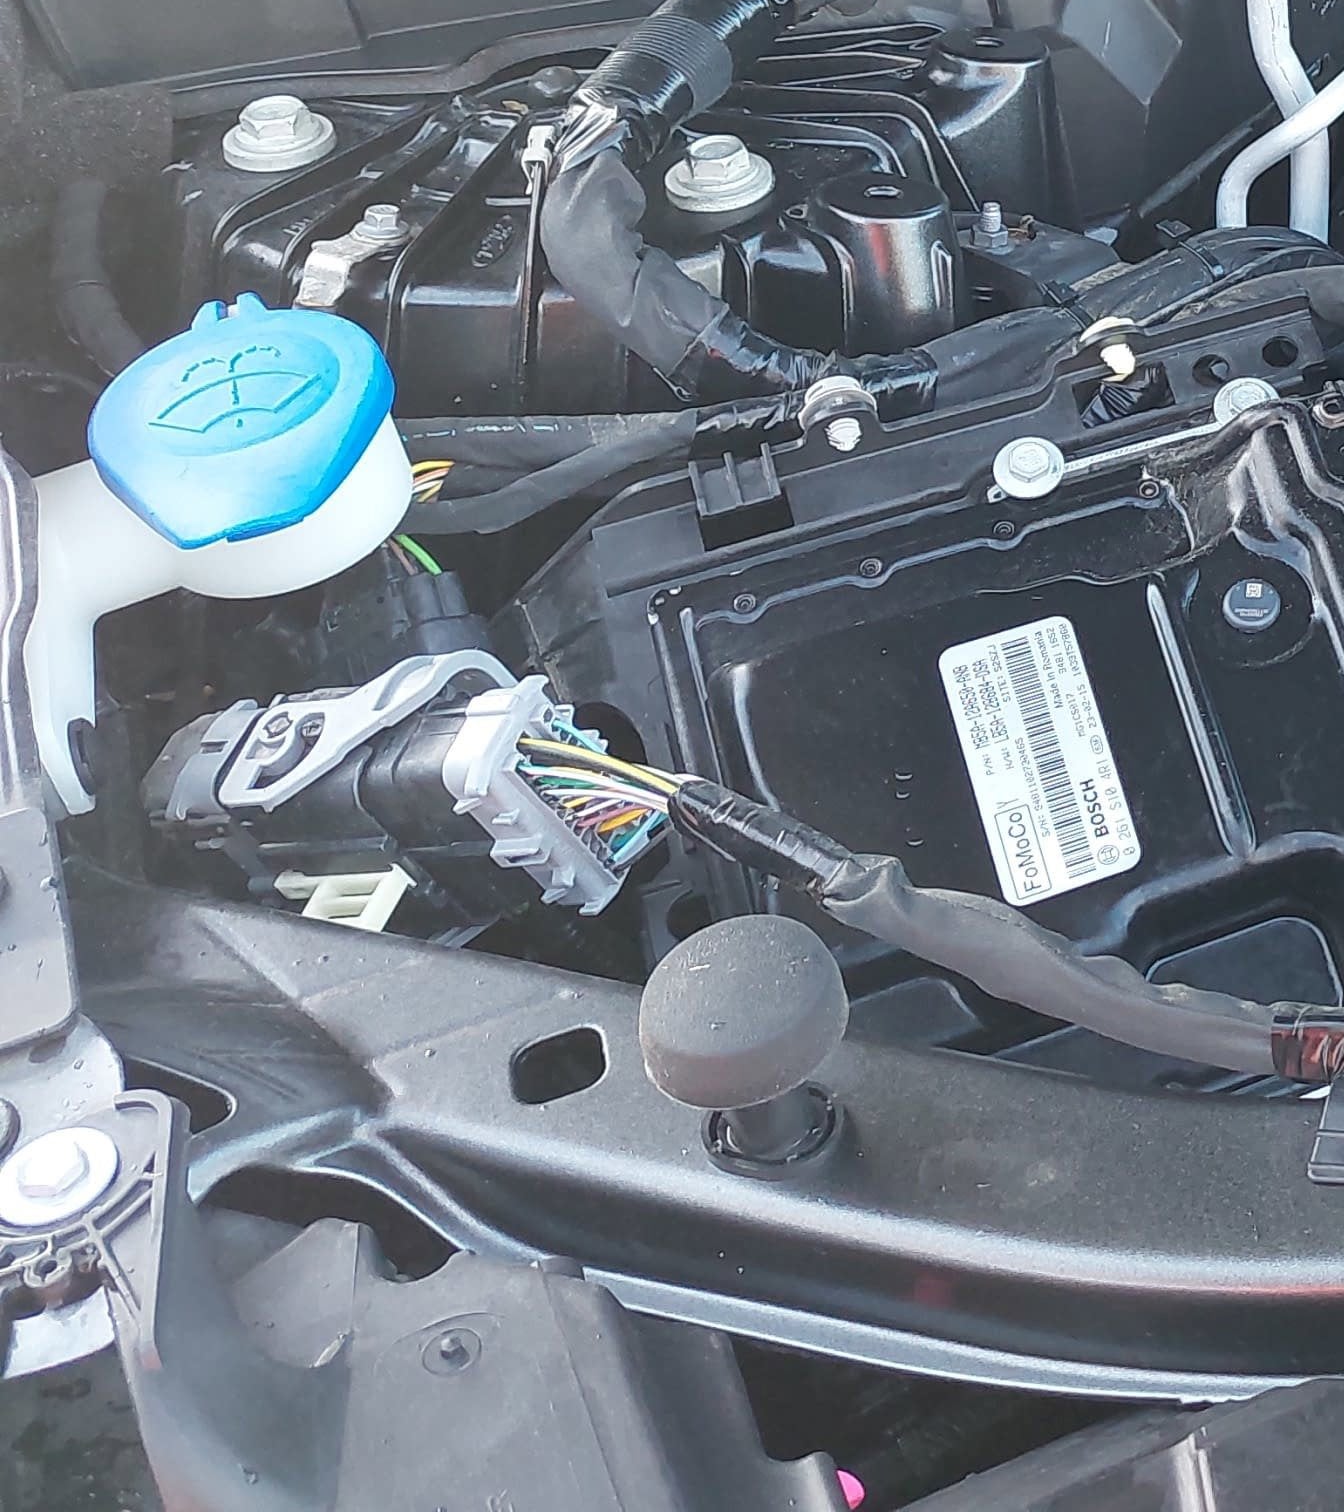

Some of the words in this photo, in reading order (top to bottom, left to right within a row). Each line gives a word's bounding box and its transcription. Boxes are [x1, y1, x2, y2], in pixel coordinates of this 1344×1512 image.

[1033, 630, 1053, 671] Romania
[1049, 682, 1064, 709] Made
[1079, 778, 1110, 839] BOSCH
[1007, 811, 1042, 893] FoMoCo
